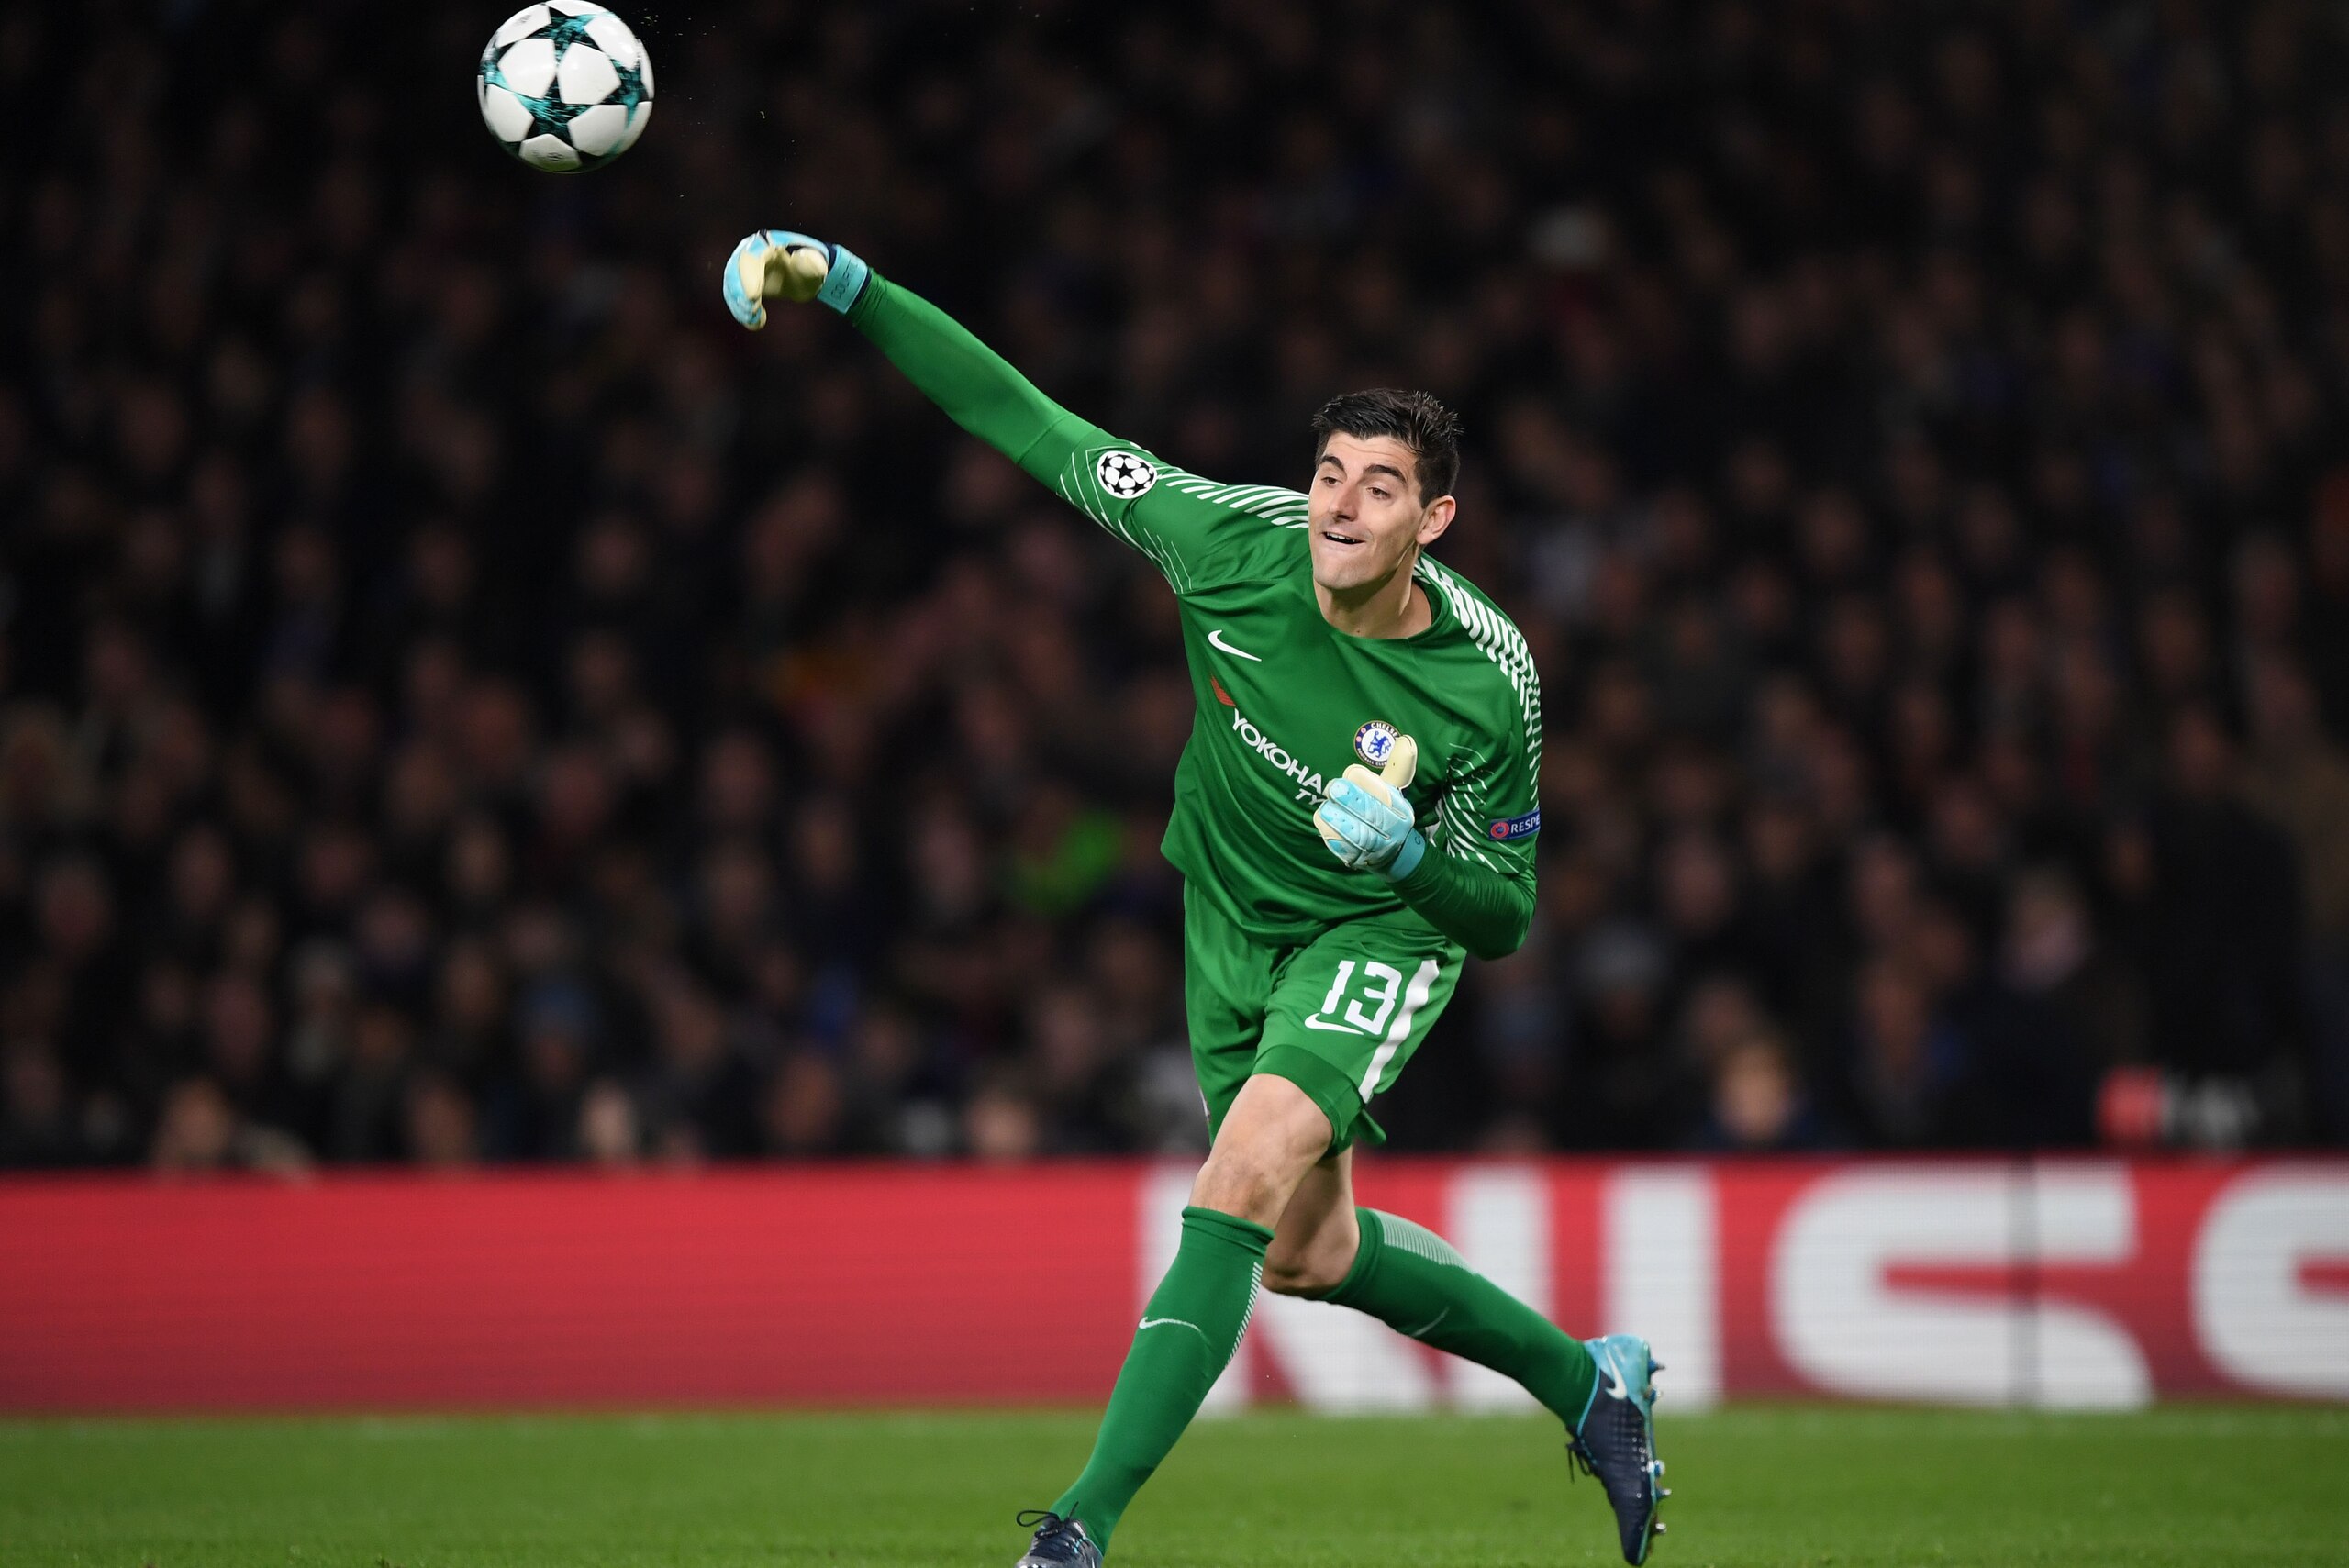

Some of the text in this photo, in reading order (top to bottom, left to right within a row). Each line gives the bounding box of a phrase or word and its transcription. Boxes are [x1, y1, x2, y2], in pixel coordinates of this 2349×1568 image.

[1232, 707, 1322, 794] YOKOHA
[1295, 788, 1327, 806] TY
[1510, 813, 1541, 834] RESPE
[1320, 960, 1402, 1036] 13
